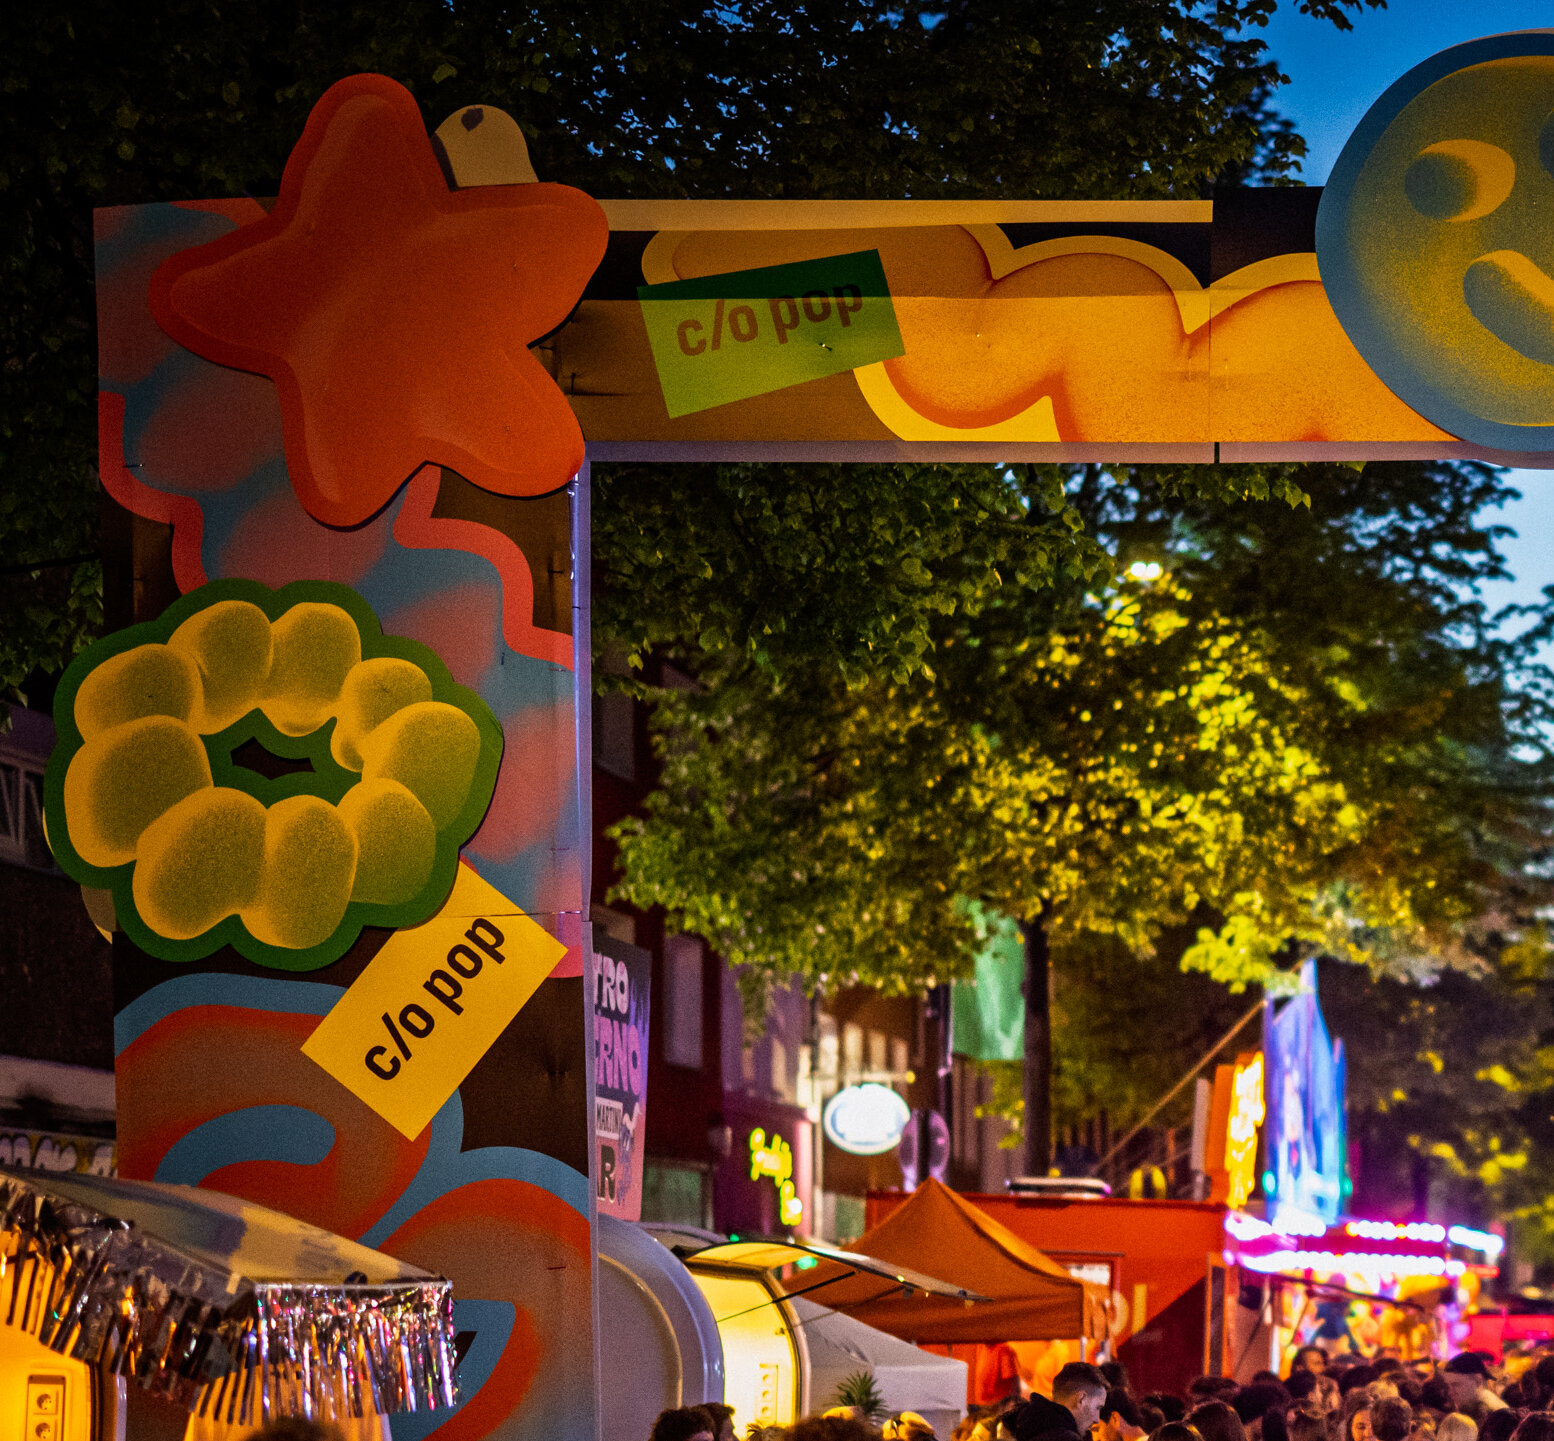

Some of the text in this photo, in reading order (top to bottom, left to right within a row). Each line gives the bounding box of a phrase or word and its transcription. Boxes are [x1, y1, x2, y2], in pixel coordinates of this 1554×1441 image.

[676, 283, 863, 357] c/o pop
[364, 917, 506, 1081] c/o pop
